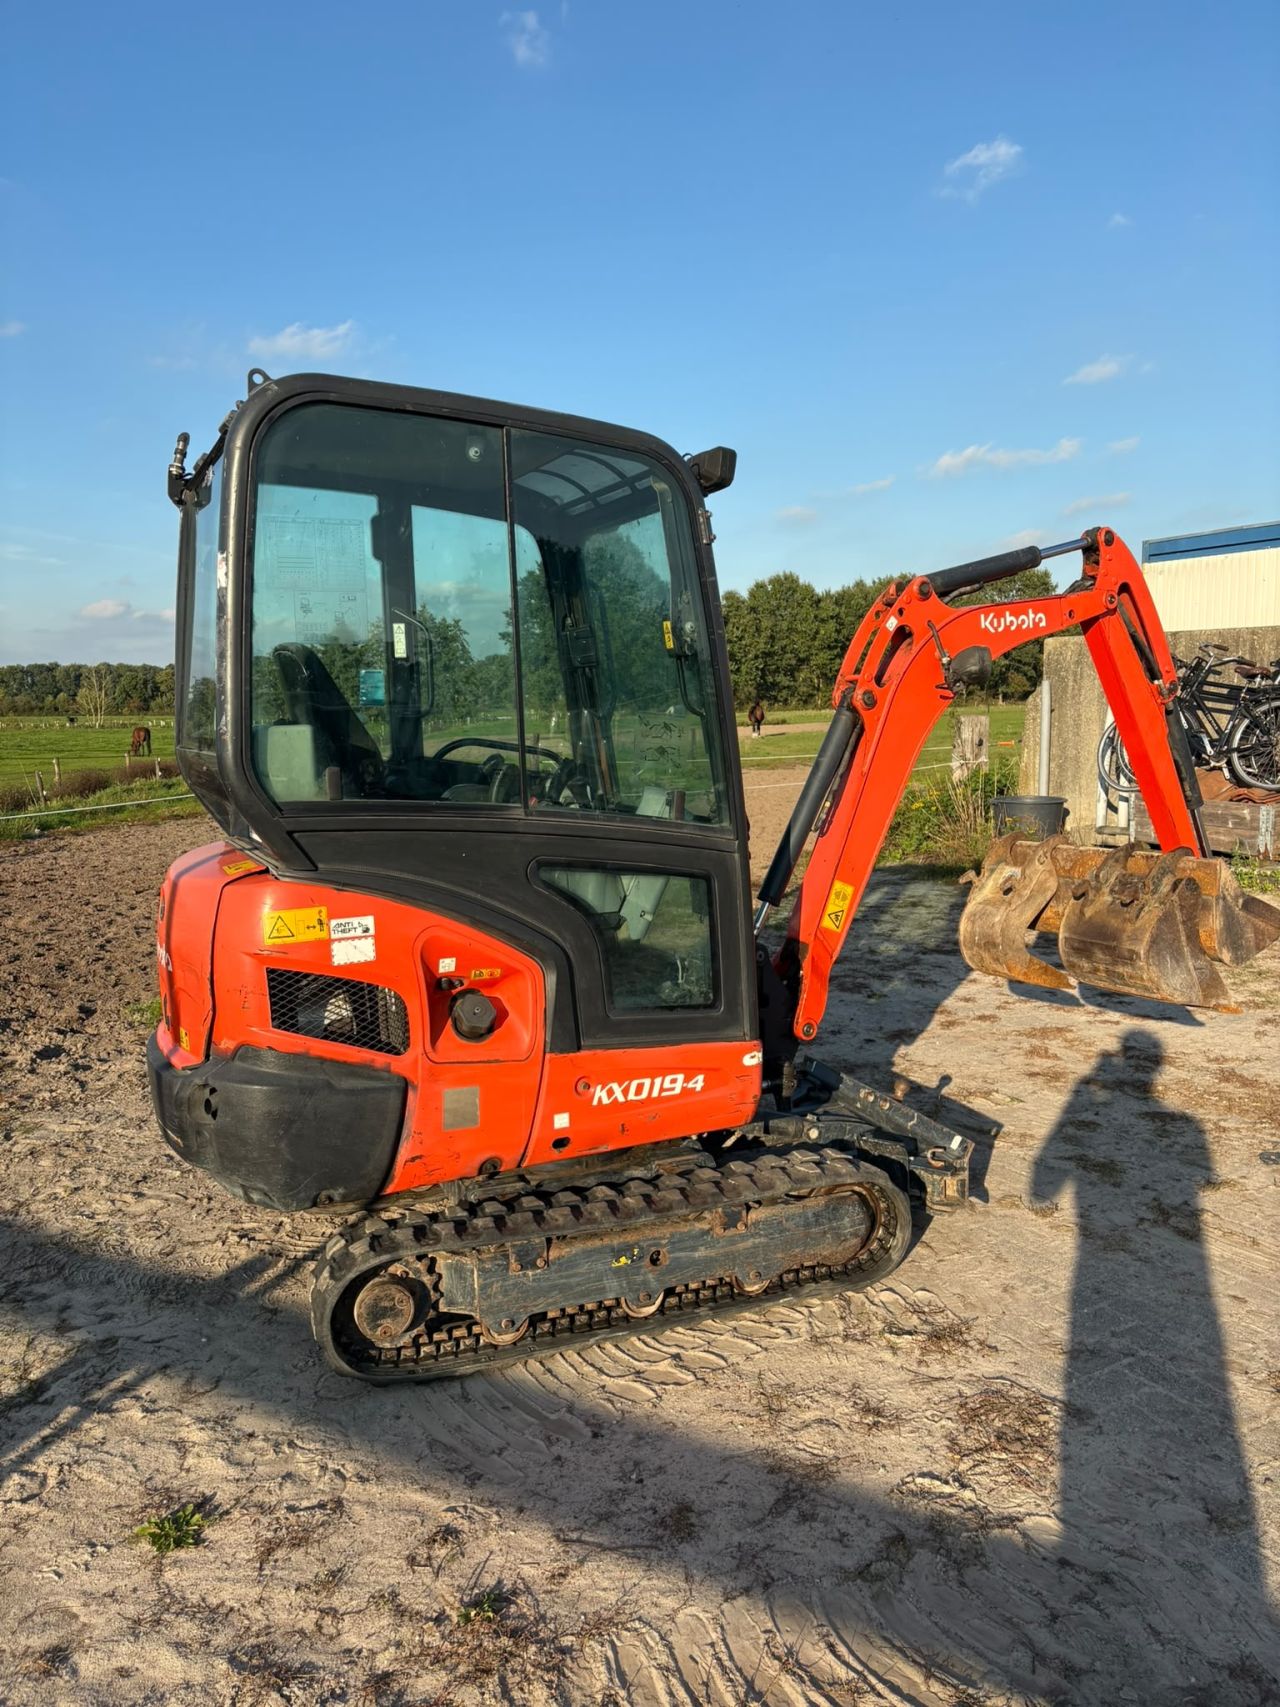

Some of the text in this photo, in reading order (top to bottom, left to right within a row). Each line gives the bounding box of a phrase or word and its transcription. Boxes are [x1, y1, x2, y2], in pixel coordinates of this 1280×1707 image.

[980, 608, 1047, 634] Kubota
[332, 926, 358, 935] THEFT
[592, 1073, 705, 1106] KX019-4
